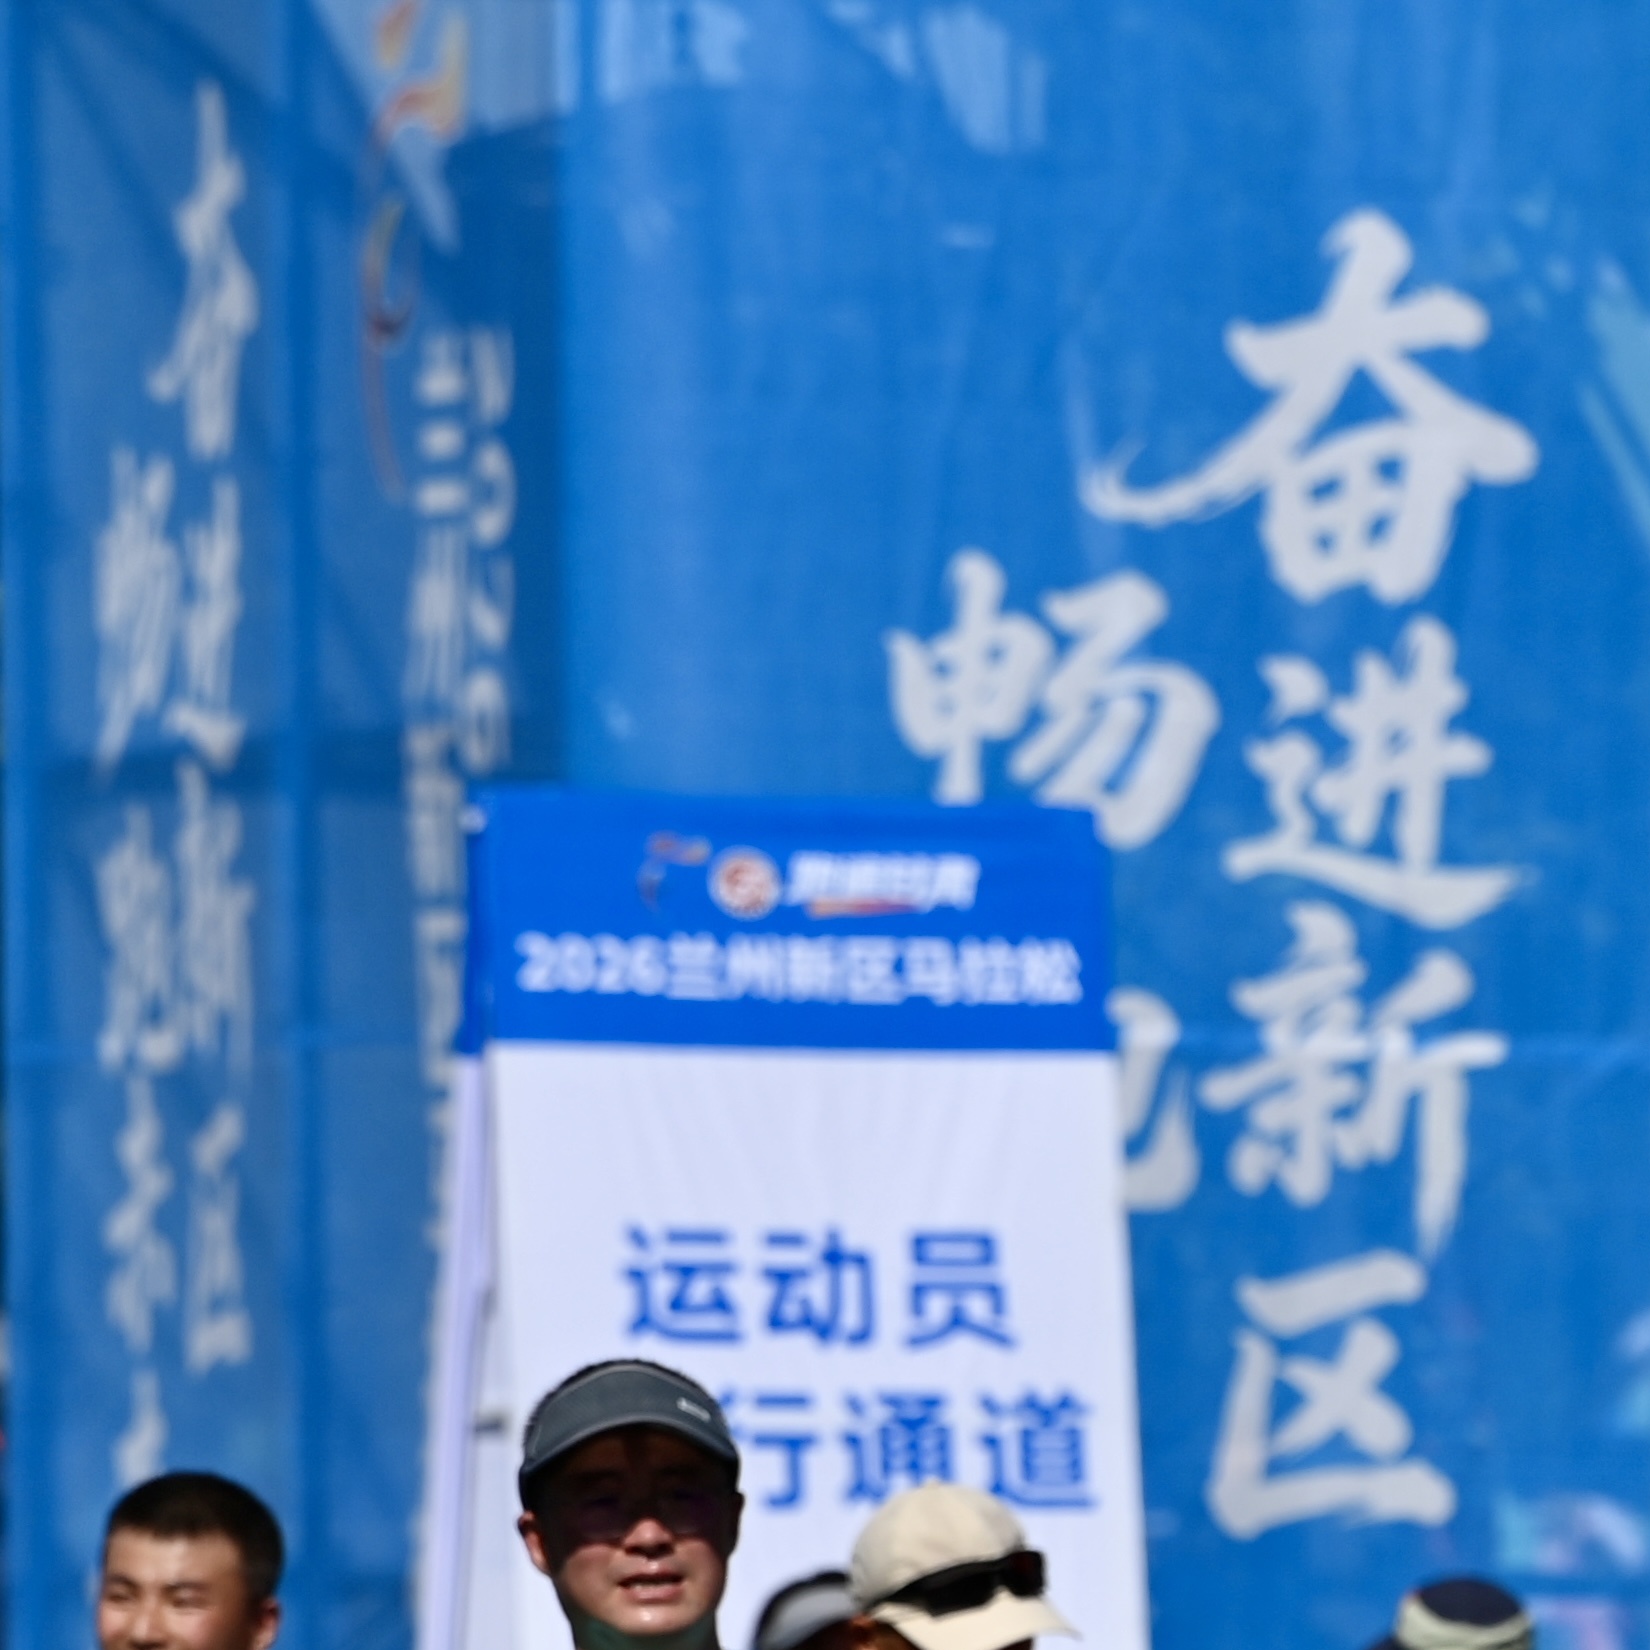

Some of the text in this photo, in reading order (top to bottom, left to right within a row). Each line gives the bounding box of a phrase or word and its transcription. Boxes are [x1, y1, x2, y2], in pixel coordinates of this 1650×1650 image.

[1078, 208, 1542, 1541] 奋进新区
[622, 1226, 1018, 1350] 运动员
[722, 1386, 1102, 1512] 行通道
